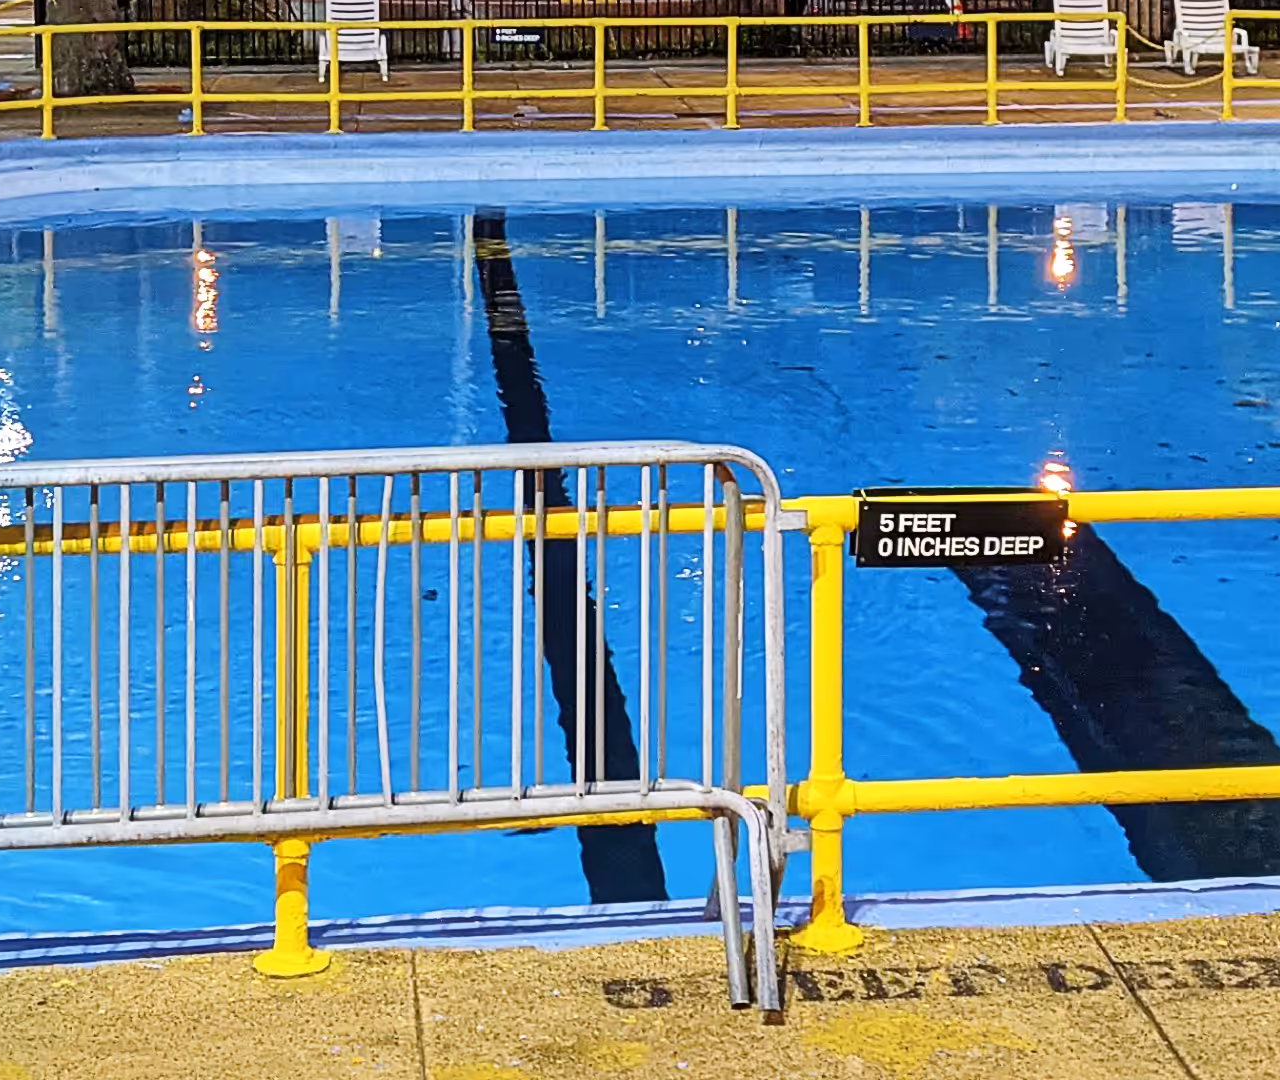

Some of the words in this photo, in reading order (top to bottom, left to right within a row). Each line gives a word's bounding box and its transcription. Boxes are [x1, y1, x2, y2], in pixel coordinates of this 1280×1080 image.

[879, 513, 895, 533] 5
[899, 513, 956, 532] FEET
[878, 537, 893, 557] 0
[897, 537, 980, 556] INCHES
[984, 536, 1044, 555] DEEP
